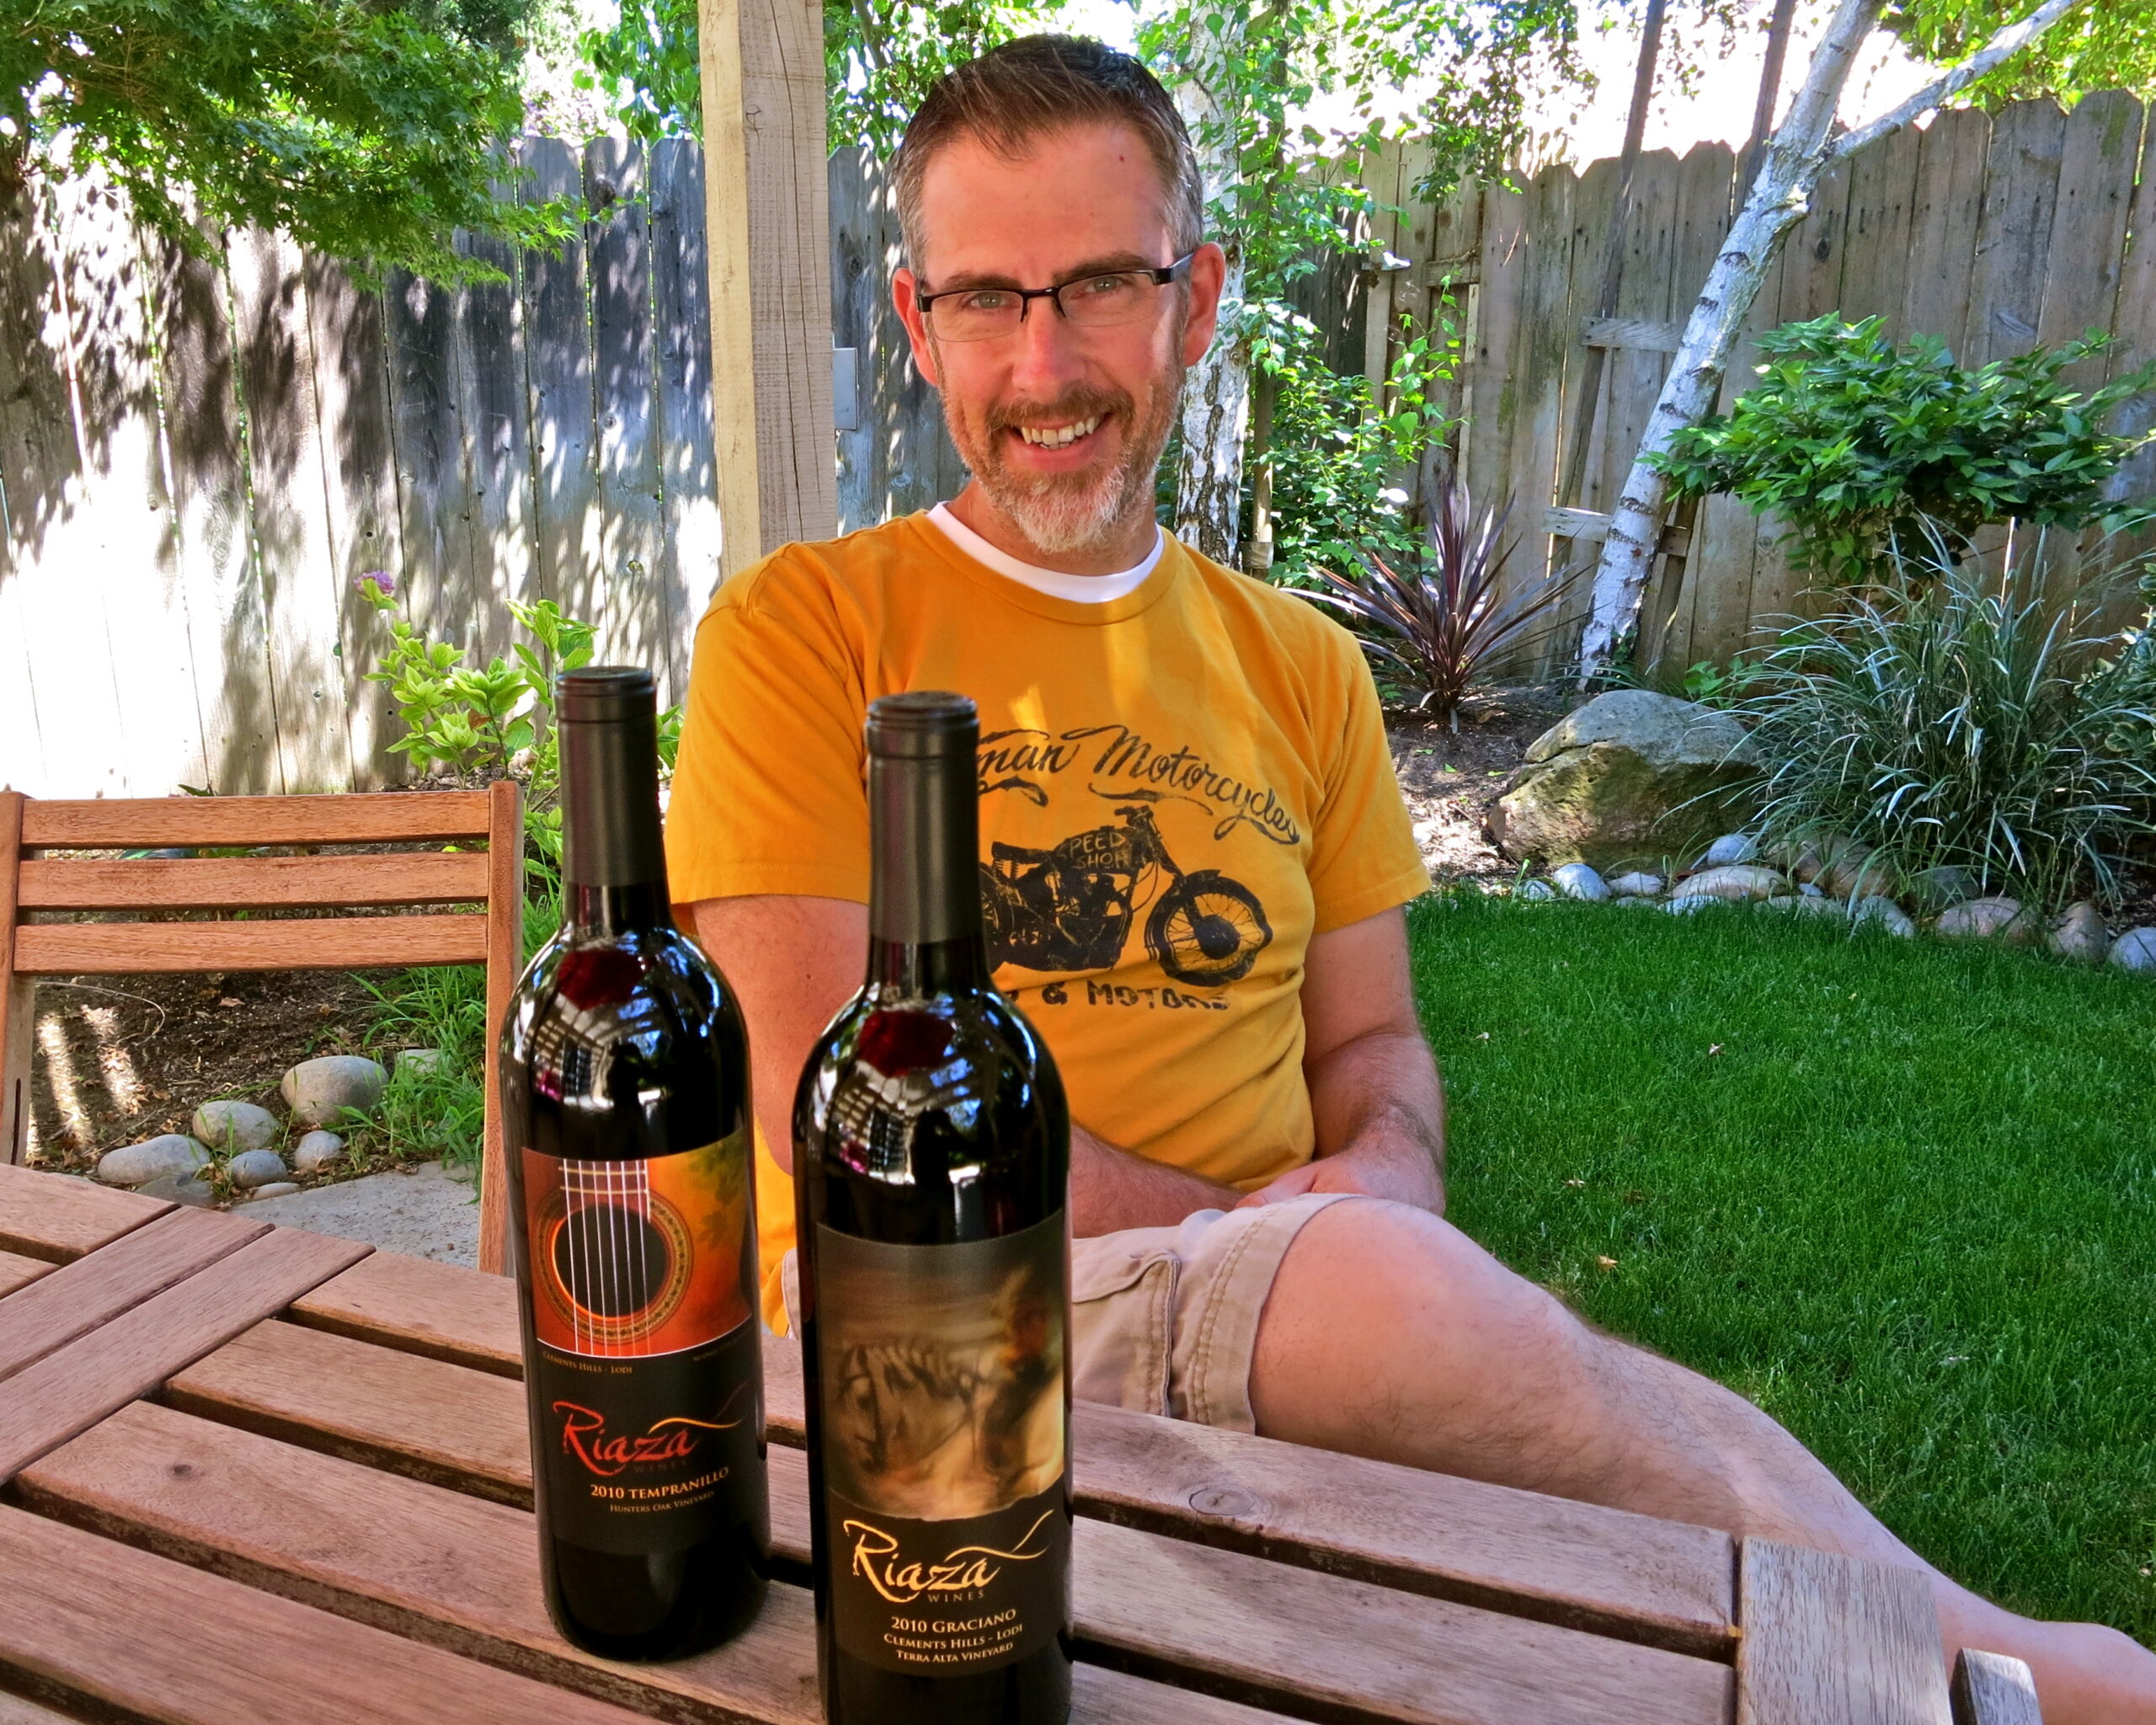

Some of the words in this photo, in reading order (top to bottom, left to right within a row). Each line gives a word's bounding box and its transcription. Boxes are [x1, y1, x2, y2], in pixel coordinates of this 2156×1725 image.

[977, 744, 1081, 777] man
[1059, 724, 1299, 845] Motorcycles
[1056, 831, 1126, 858] SPEED
[611, 1365, 632, 1375] LODI
[552, 1400, 701, 1476] Riaza
[590, 1483, 624, 1499] 2010
[628, 1466, 729, 1500] TEMPRANILLO
[610, 1503, 651, 1514] HUNTERS
[653, 1503, 671, 1511] OAK
[673, 1490, 714, 1508] VINEYARD
[843, 1519, 1001, 1603] Riaza
[928, 1589, 985, 1604] WINES
[891, 1616, 927, 1633] 2010
[932, 1608, 1017, 1633] GRACIANO
[883, 1632, 947, 1650] CLEMENTS
[951, 1636, 985, 1649] HILLS
[996, 1623, 1023, 1642] LODI
[895, 1648, 930, 1663] TERRA
[932, 1653, 958, 1663] ALTA
[961, 1642, 1014, 1662] VINEYARD
